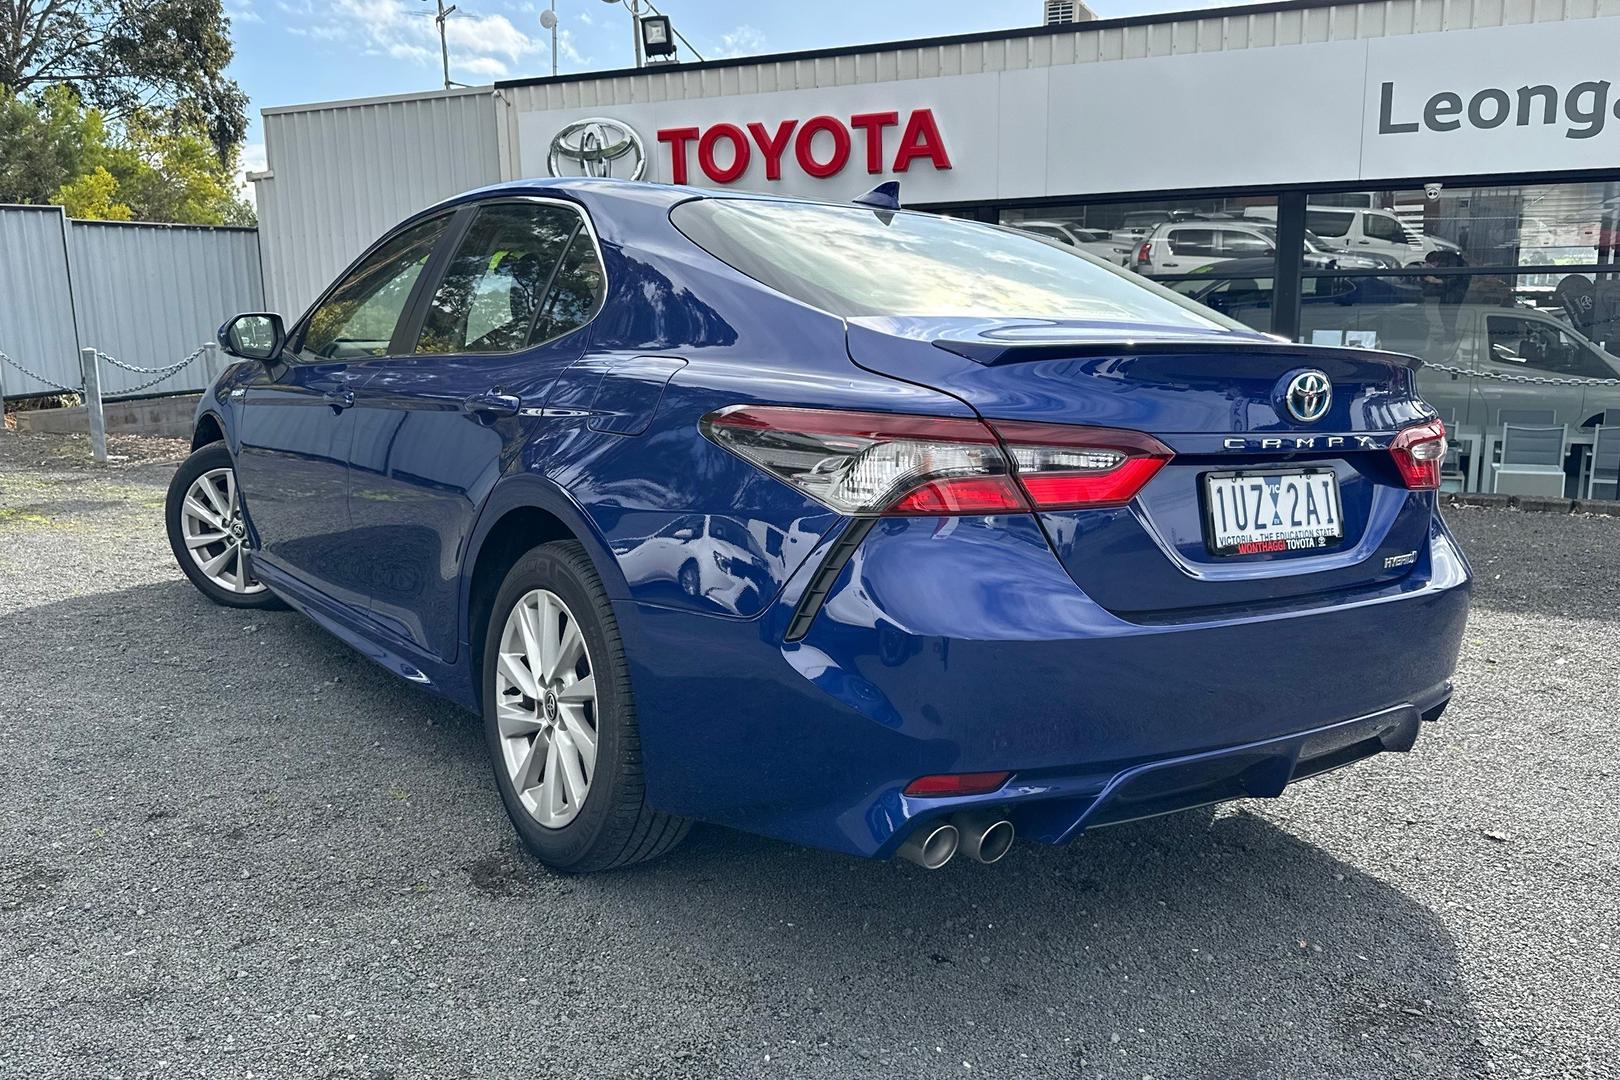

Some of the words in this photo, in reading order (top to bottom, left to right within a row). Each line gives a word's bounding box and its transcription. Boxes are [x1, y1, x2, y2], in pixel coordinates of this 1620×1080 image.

[1378, 80, 1620, 139] Leong
[657, 108, 952, 185] TOYOTA
[1224, 436, 1371, 449] CAMRY
[1267, 484, 1281, 494] VIC
[1219, 534, 1253, 546] VICTORIA
[1259, 533, 1274, 541] THE
[1276, 530, 1314, 540] EDUCATION
[1315, 528, 1335, 537] STATE
[1238, 540, 1286, 554] WONTHAGGI
[1286, 538, 1315, 550] TOYOTA
